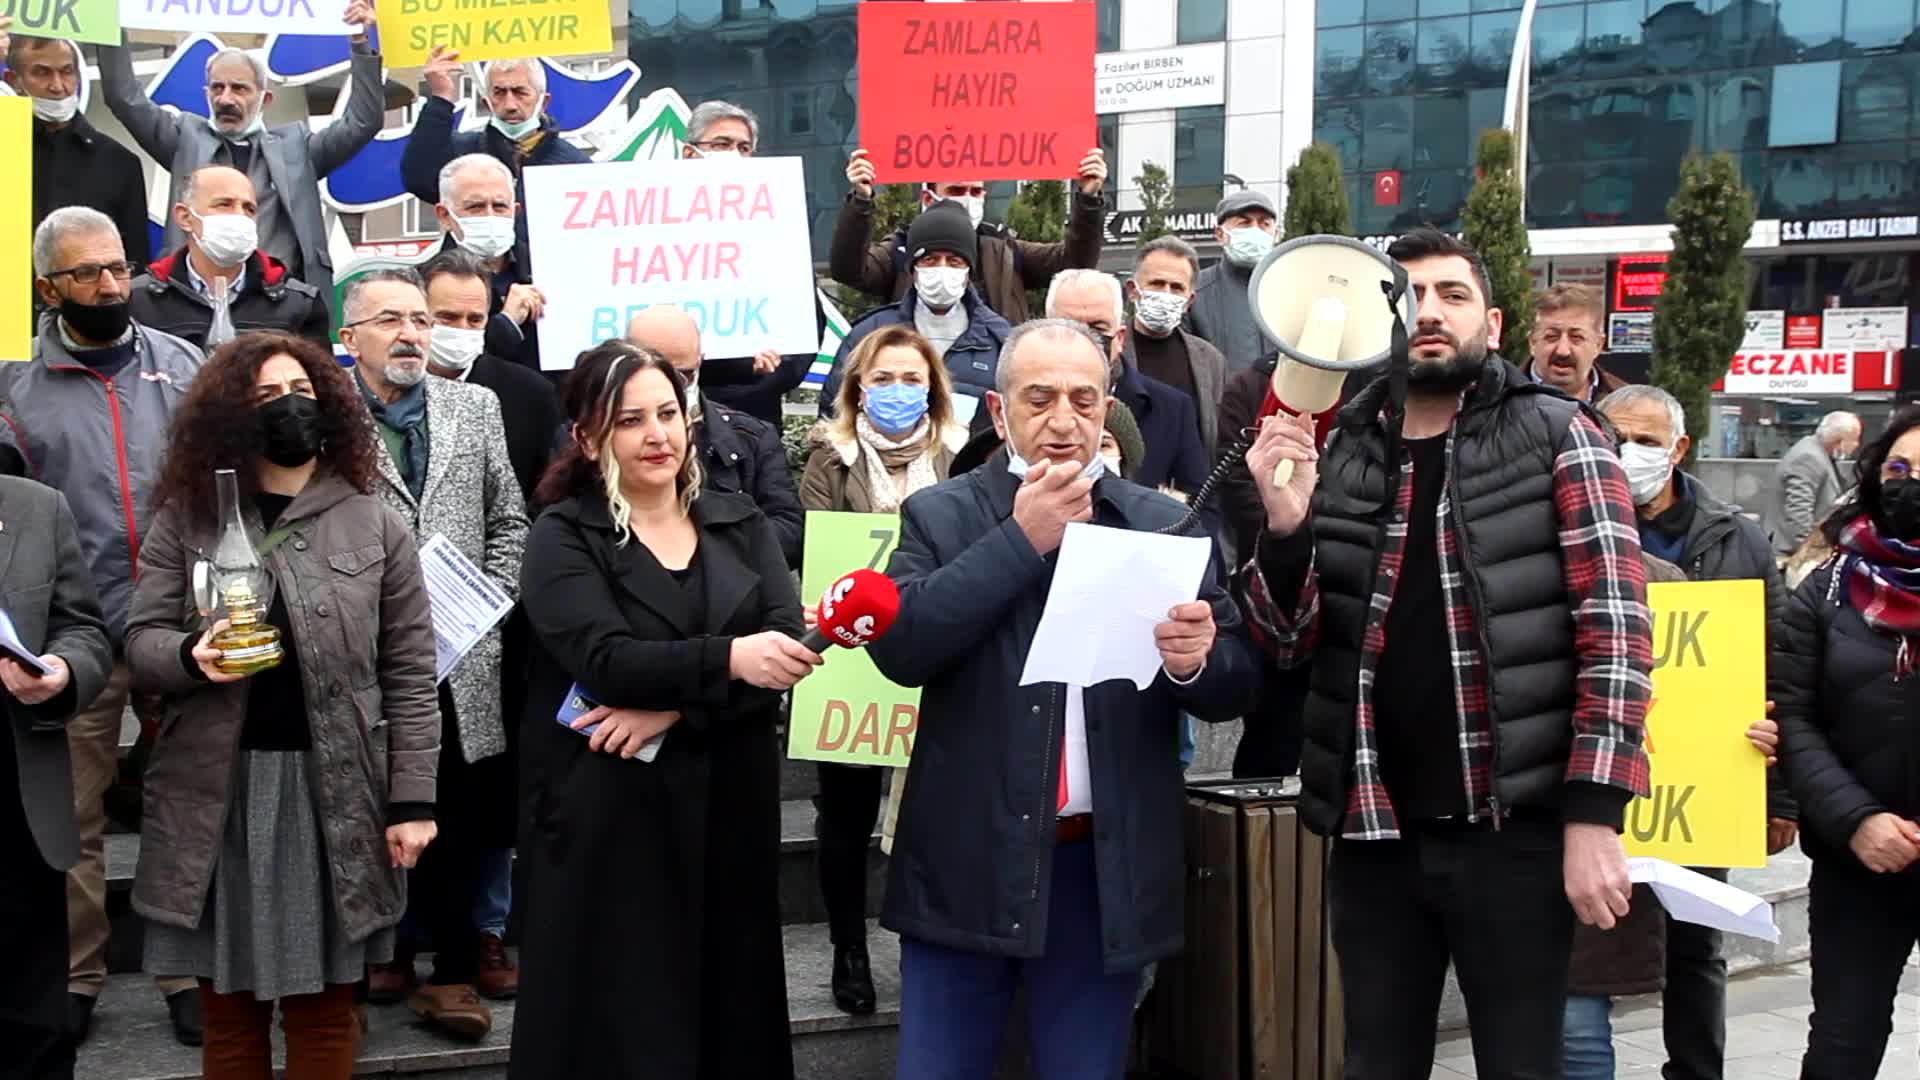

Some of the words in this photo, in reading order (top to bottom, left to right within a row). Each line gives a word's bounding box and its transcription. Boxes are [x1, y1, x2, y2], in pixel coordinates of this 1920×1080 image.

[410, 22, 471, 50] SEN
[483, 15, 579, 45] KAYIR
[903, 19, 1043, 55] ZAMLARA
[1104, 61, 1140, 73] Fazilet
[931, 72, 1017, 107] HAYIR
[1099, 86, 1113, 95] ve
[1116, 78, 1163, 94] DOĞUM
[1167, 75, 1215, 89] UZMANI
[894, 125, 1058, 168] BOĞALDUK
[563, 183, 775, 230] ZAMLARA
[1120, 216, 1142, 233] AK
[1807, 220, 1847, 240] ANZER
[611, 242, 741, 285] HAYIR
[591, 298, 769, 346] BDUK
[1731, 352, 1847, 376] ECZANE
[1768, 379, 1808, 389] DUYGU
[816, 699, 918, 757] DAR
